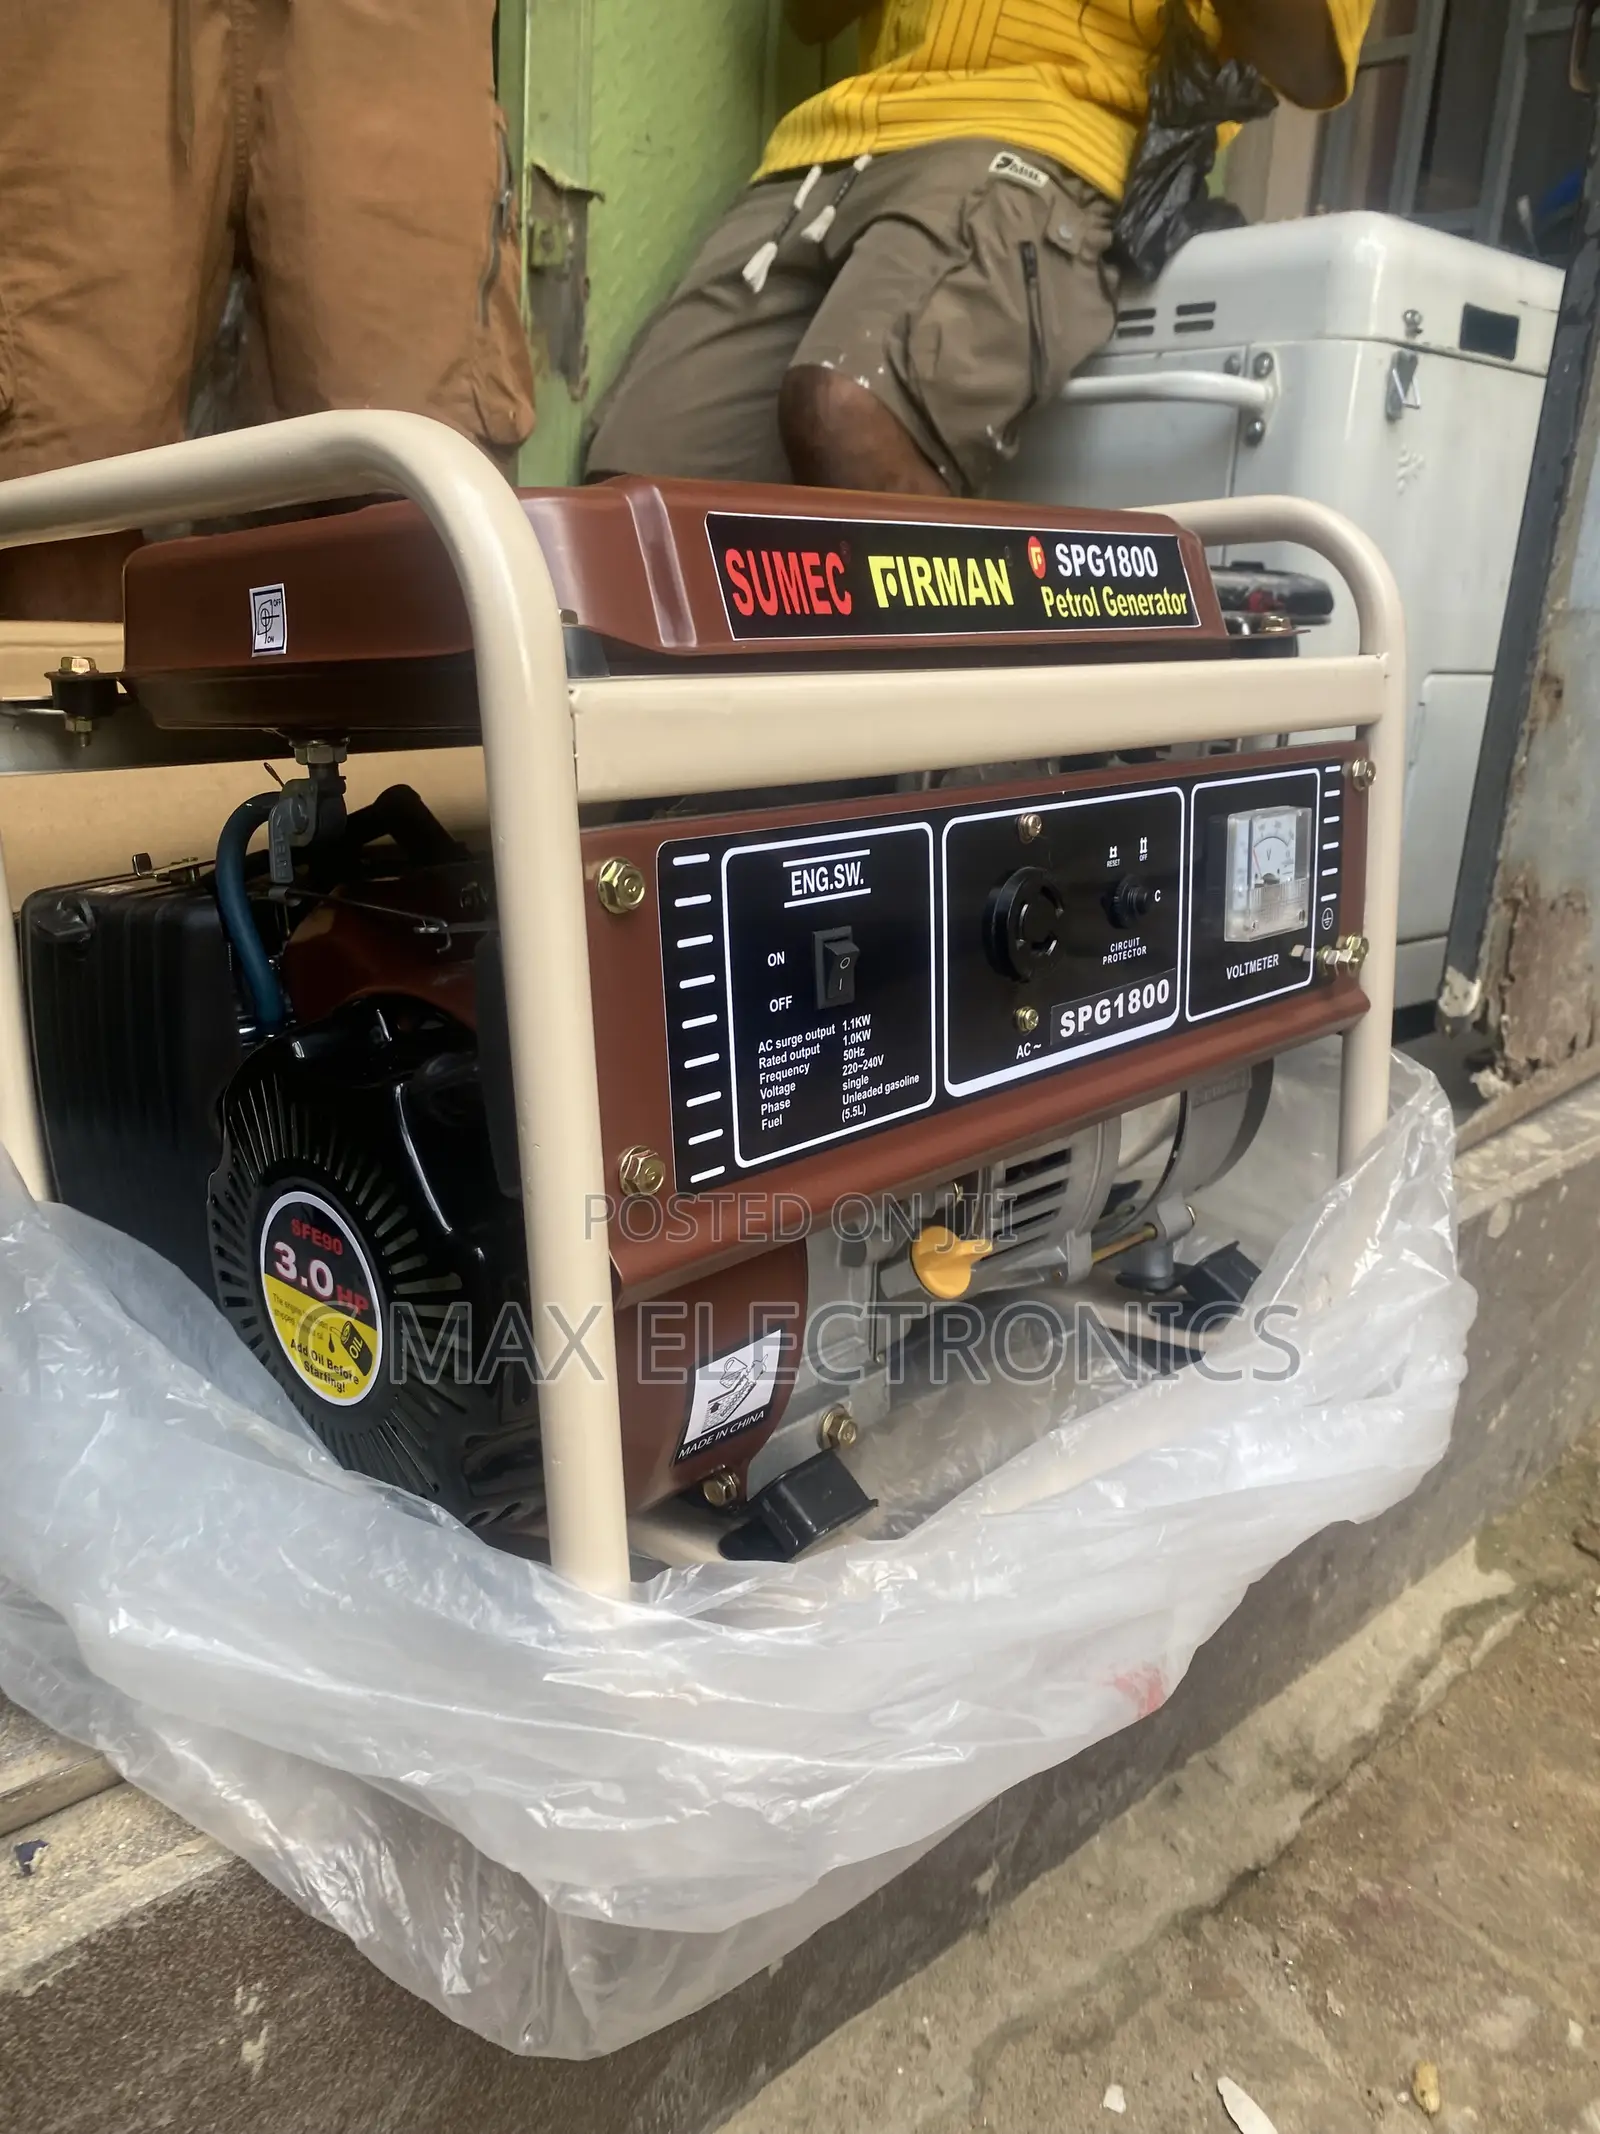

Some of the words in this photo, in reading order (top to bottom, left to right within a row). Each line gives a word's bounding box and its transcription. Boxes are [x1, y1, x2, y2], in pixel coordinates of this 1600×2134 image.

[1055, 542, 1159, 579] SPG1800
[724, 547, 852, 617] SUMEC
[867, 554, 1015, 609] FIRMAN
[1039, 584, 1102, 619] Petrol
[1105, 586, 1188, 617] Generator
[1106, 858, 1121, 868] RESET
[1139, 854, 1148, 862] OFF
[790, 861, 865, 896] ENG.SW.
[1154, 889, 1161, 902] C
[767, 951, 786, 967] ON
[1102, 946, 1148, 965] PROTECTOR
[1110, 937, 1141, 953] CIRCUIT
[1226, 953, 1280, 981] VOLTMETER
[769, 995, 793, 1013] OFF
[1059, 978, 1171, 1038] SPG1800
[758, 1039, 774, 1054] AC
[775, 1033, 803, 1049] surge
[805, 1023, 836, 1040] output
[842, 1013, 872, 1031] 1.1KW
[759, 1051, 787, 1069] Rated
[789, 1043, 821, 1059] output
[843, 1029, 872, 1046] 1.0KW
[759, 1062, 811, 1085] Frequency
[843, 1046, 865, 1061] 50Hz
[760, 1082, 796, 1100] Voltage
[842, 1054, 884, 1076] 220~240V
[761, 1099, 791, 1116] Phase
[842, 1074, 869, 1091] single
[761, 1114, 783, 1131] Fuel
[842, 1083, 883, 1105] Unleaded
[884, 1074, 920, 1095] gasoline
[841, 1103, 867, 1123] (5.5L)
[290, 1218, 343, 1255] SFE90
[273, 1240, 335, 1299] 3.0
[336, 1284, 370, 1316] HP
[290, 1338, 309, 1357] Add
[311, 1349, 324, 1367] Oil
[326, 1357, 360, 1385] Before
[349, 1338, 364, 1359] OIL
[303, 1359, 346, 1393] Starting!
[678, 1435, 715, 1459] MADE
[715, 1427, 729, 1441] IN
[730, 1410, 765, 1433] CHINA
